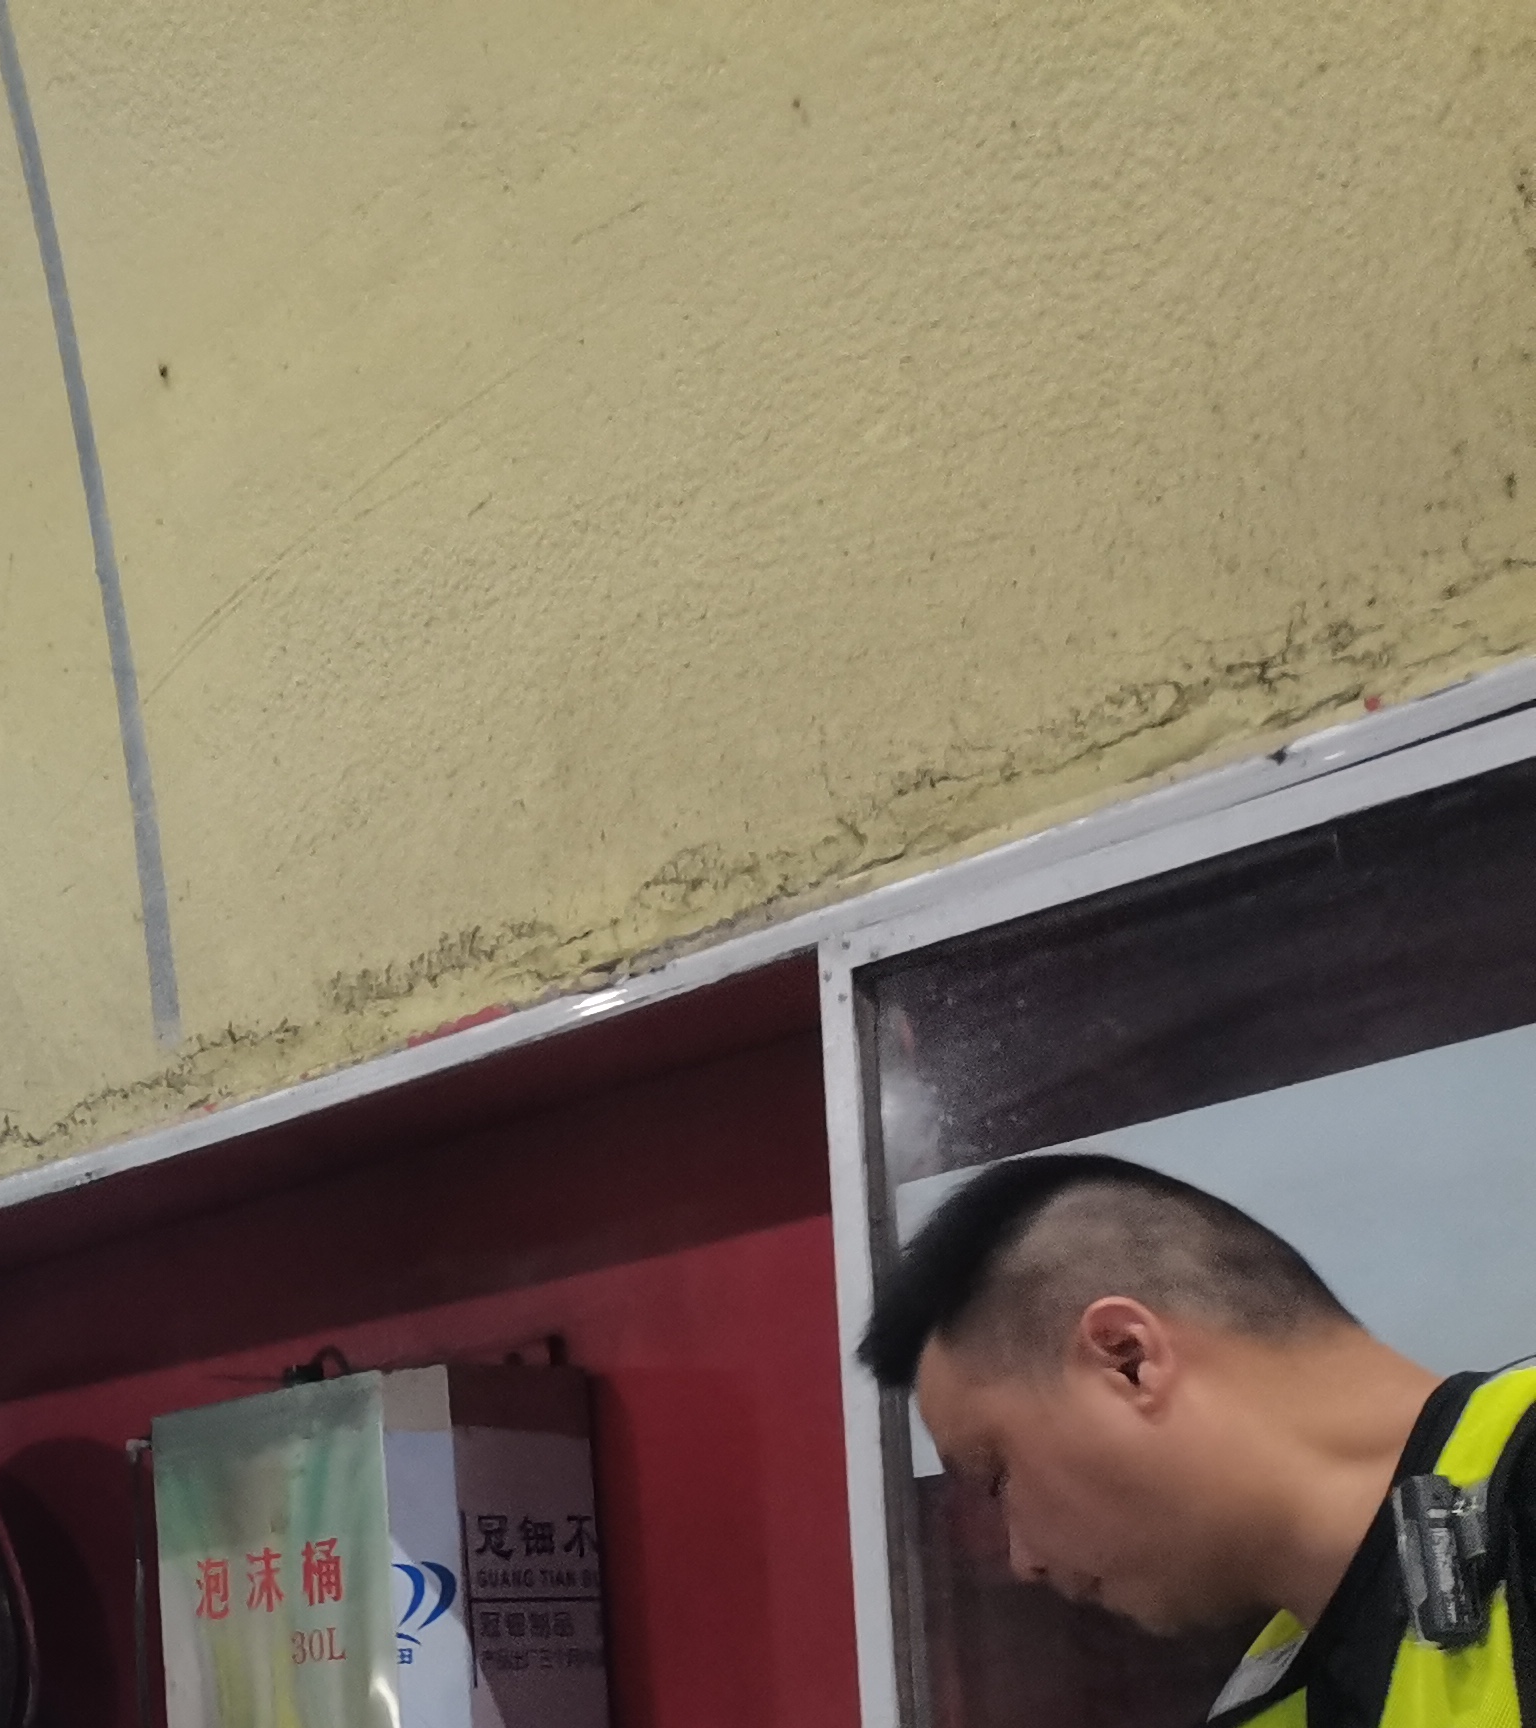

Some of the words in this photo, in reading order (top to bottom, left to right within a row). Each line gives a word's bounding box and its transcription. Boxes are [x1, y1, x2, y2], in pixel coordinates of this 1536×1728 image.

[196, 1537, 343, 1620] 泡沫桶
[291, 1626, 347, 1664] 30L
